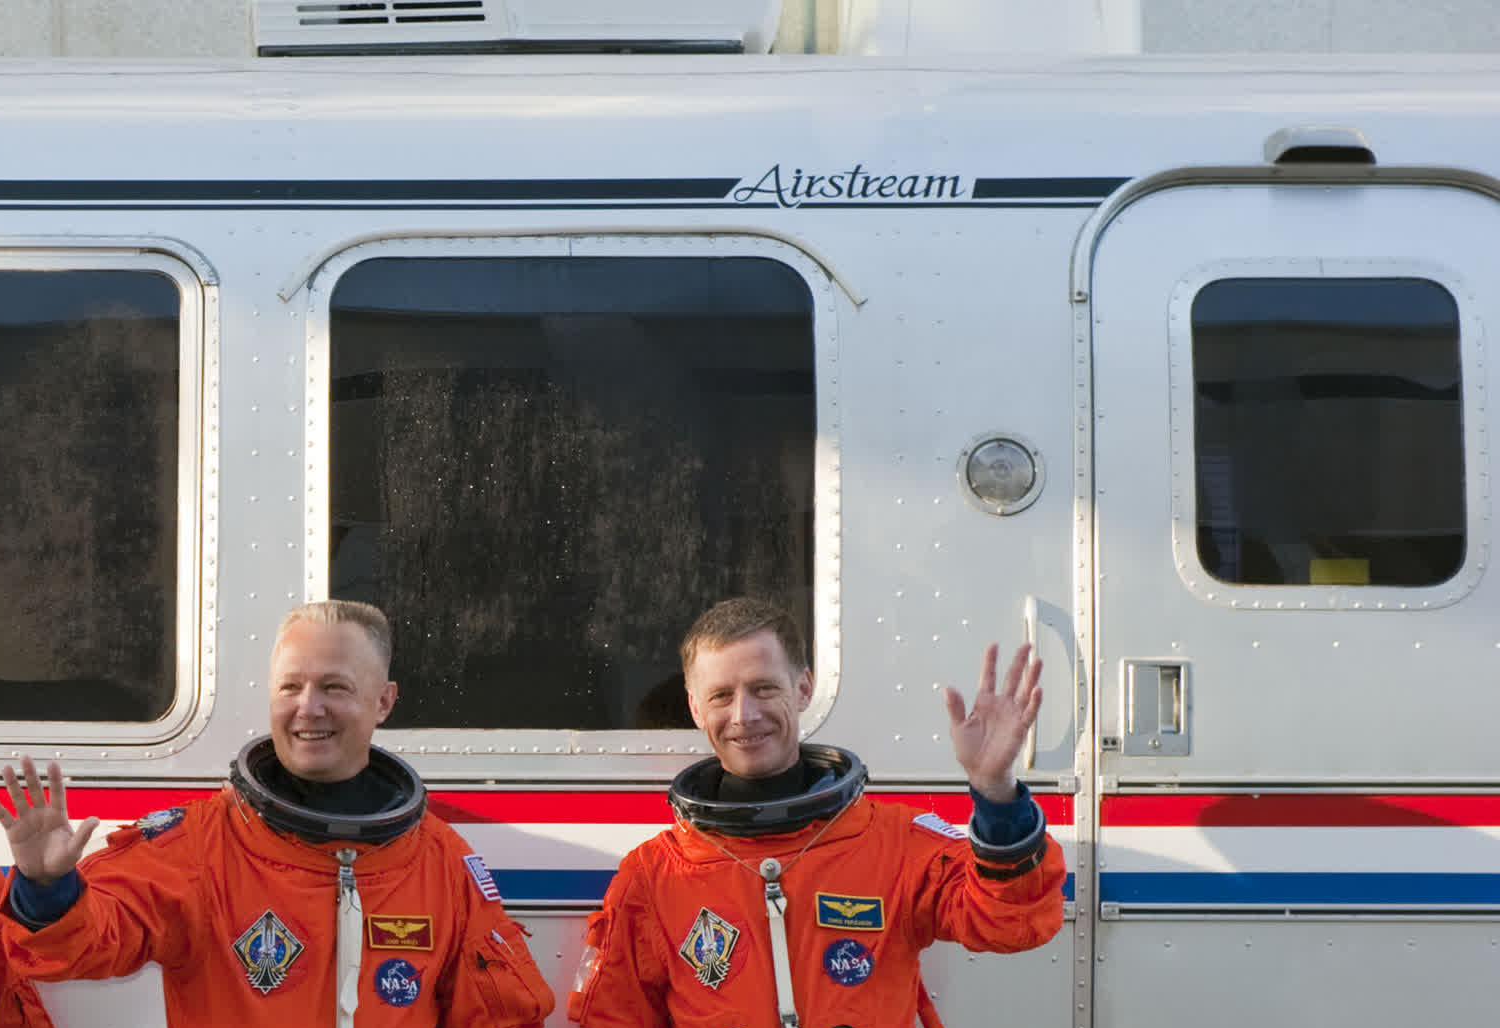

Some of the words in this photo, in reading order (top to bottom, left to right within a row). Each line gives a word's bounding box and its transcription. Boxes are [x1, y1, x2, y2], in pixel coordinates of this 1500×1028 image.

[733, 163, 966, 209] Airstream
[830, 958, 870, 972] NASA
[381, 977, 418, 993] NASA
